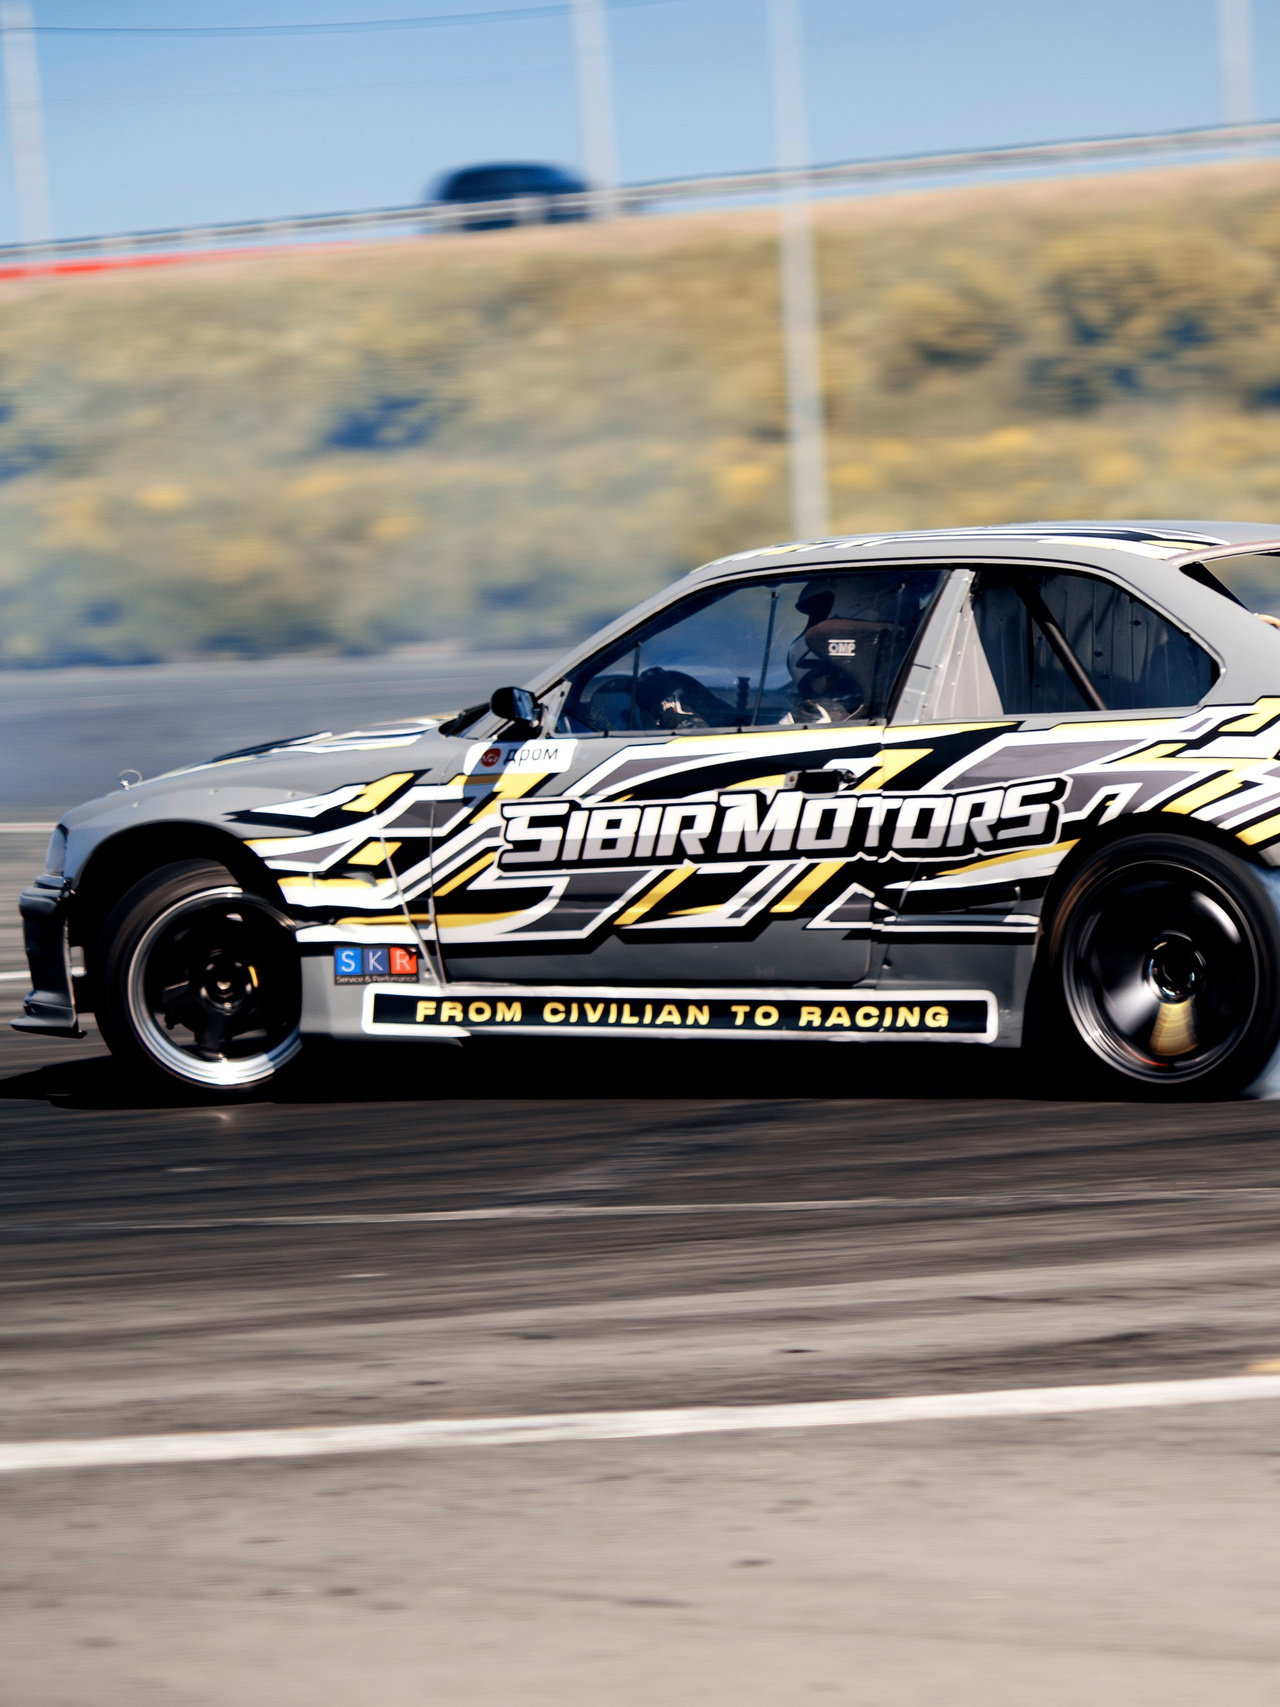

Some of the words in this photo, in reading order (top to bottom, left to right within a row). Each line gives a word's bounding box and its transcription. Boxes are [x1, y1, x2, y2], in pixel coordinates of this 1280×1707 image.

[828, 641, 856, 655] OMP
[336, 975, 364, 983] Service
[365, 975, 371, 983] &
[415, 1001, 522, 1023] FROM
[543, 1002, 709, 1025] CIVILIAN
[731, 1005, 779, 1026] TO
[798, 1006, 949, 1028] RACING
